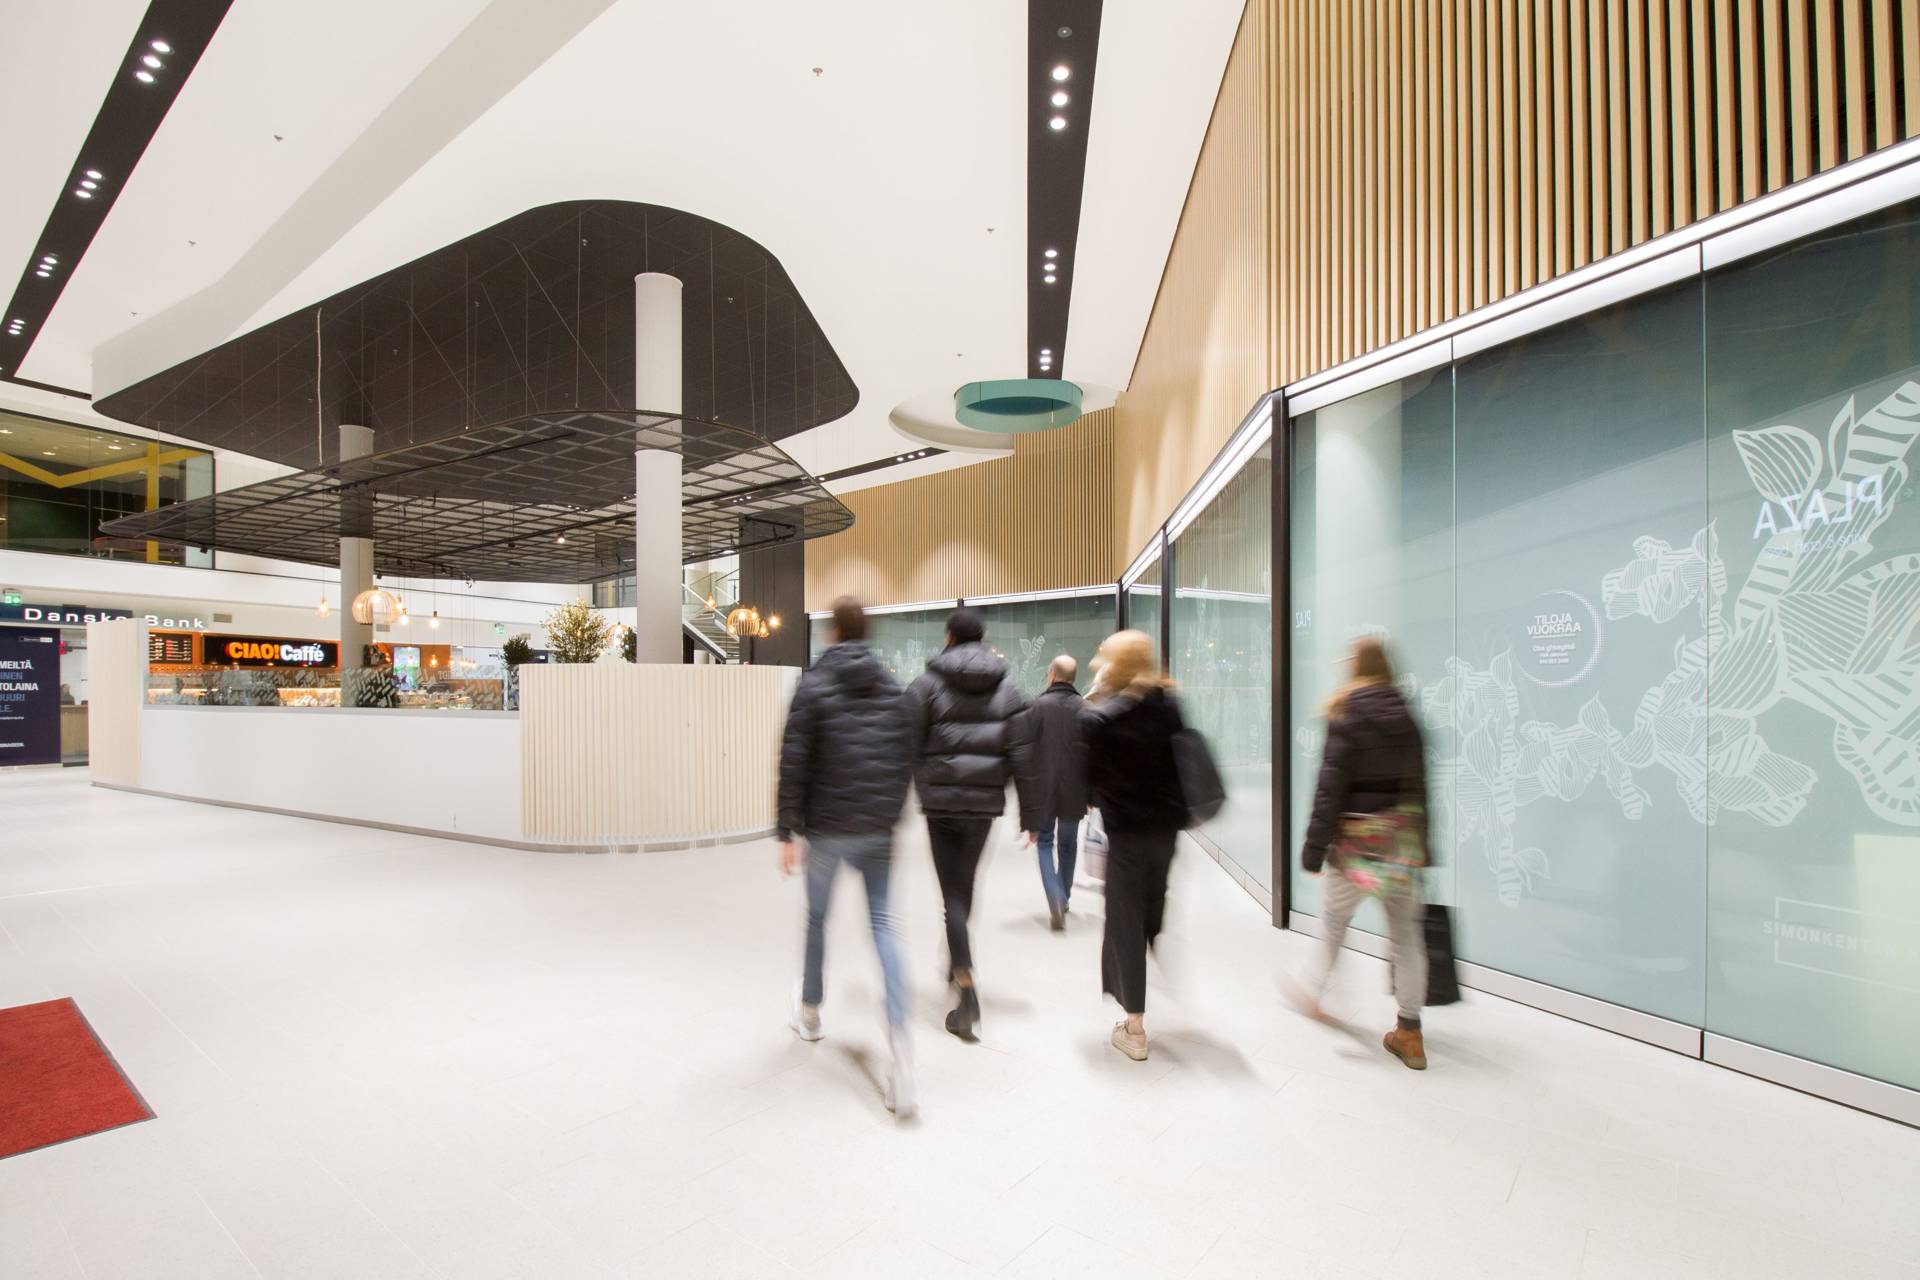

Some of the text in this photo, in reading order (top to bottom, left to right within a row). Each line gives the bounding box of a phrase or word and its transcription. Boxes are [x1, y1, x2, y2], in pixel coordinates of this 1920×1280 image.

[145, 615, 205, 629] Bank
[1534, 612, 1573, 624] TILOJA
[1527, 622, 1582, 635] VUOKRAA
